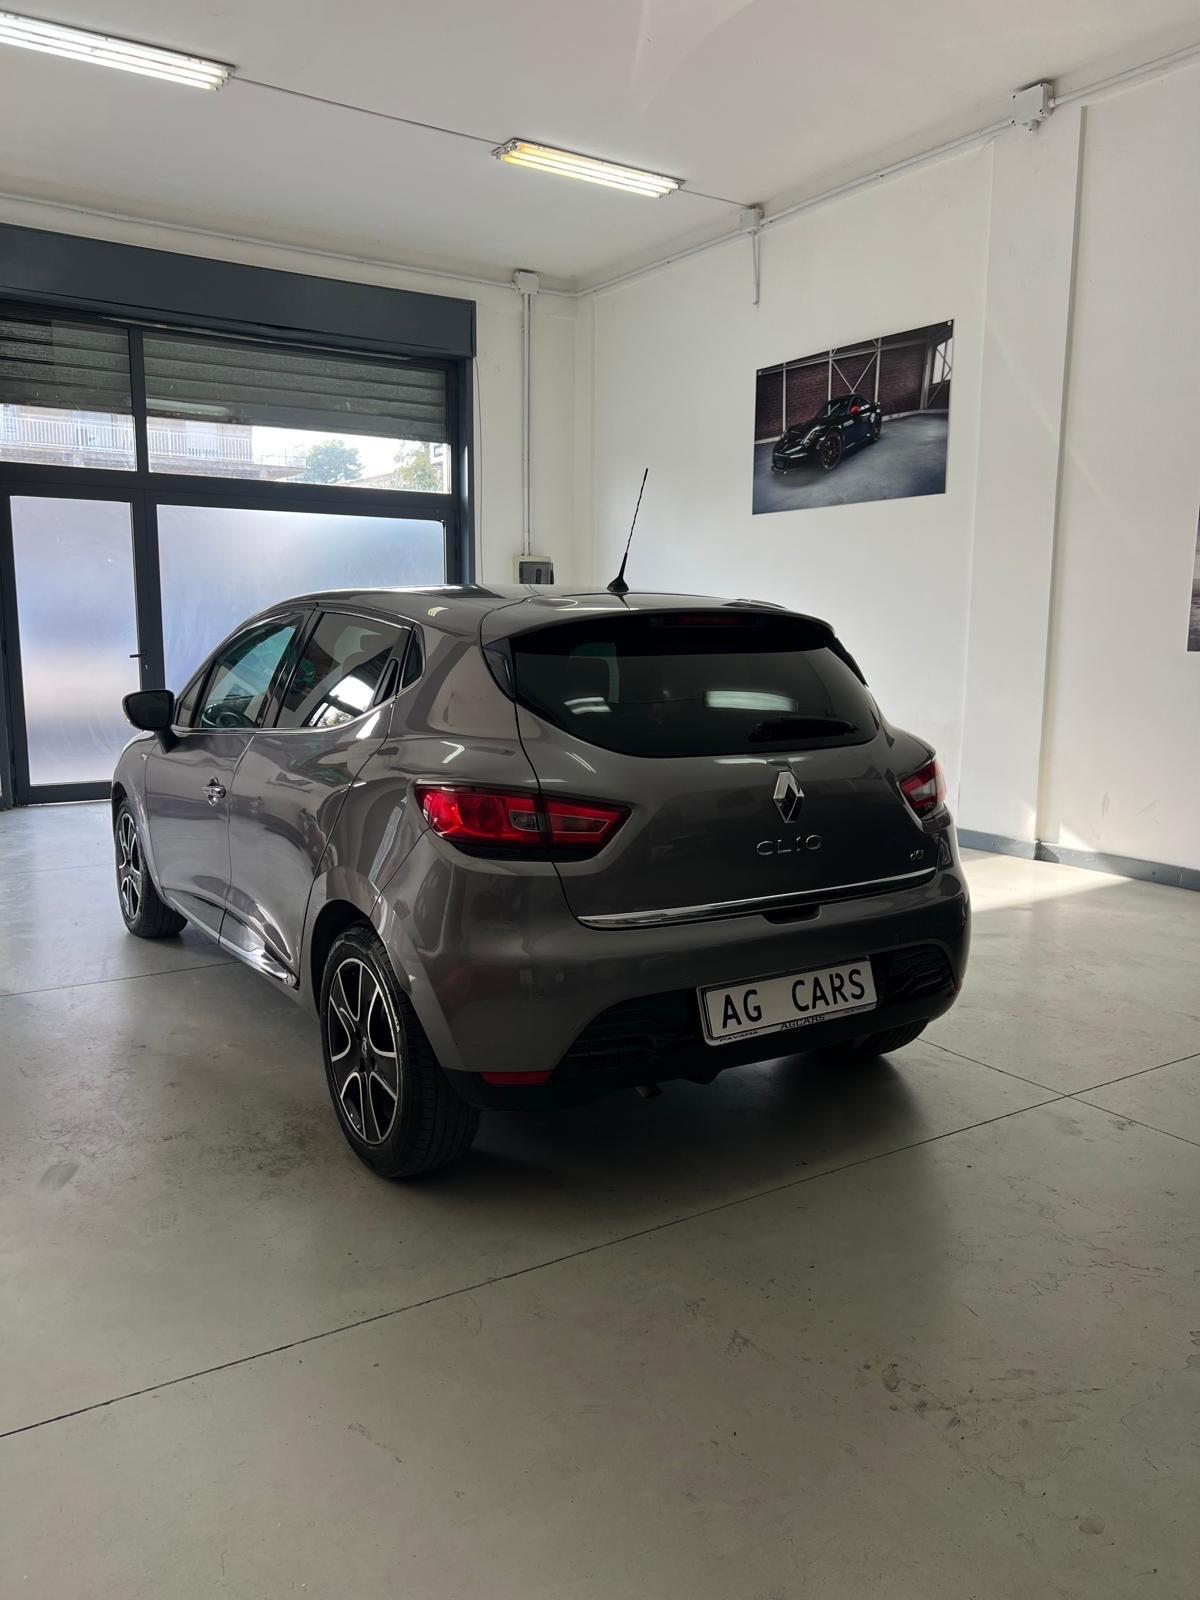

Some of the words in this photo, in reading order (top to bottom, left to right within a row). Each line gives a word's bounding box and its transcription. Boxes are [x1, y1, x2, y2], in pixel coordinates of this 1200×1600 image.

[756, 834, 823, 856] CLIO
[721, 988, 763, 1029] AG
[791, 968, 866, 1012] CARS
